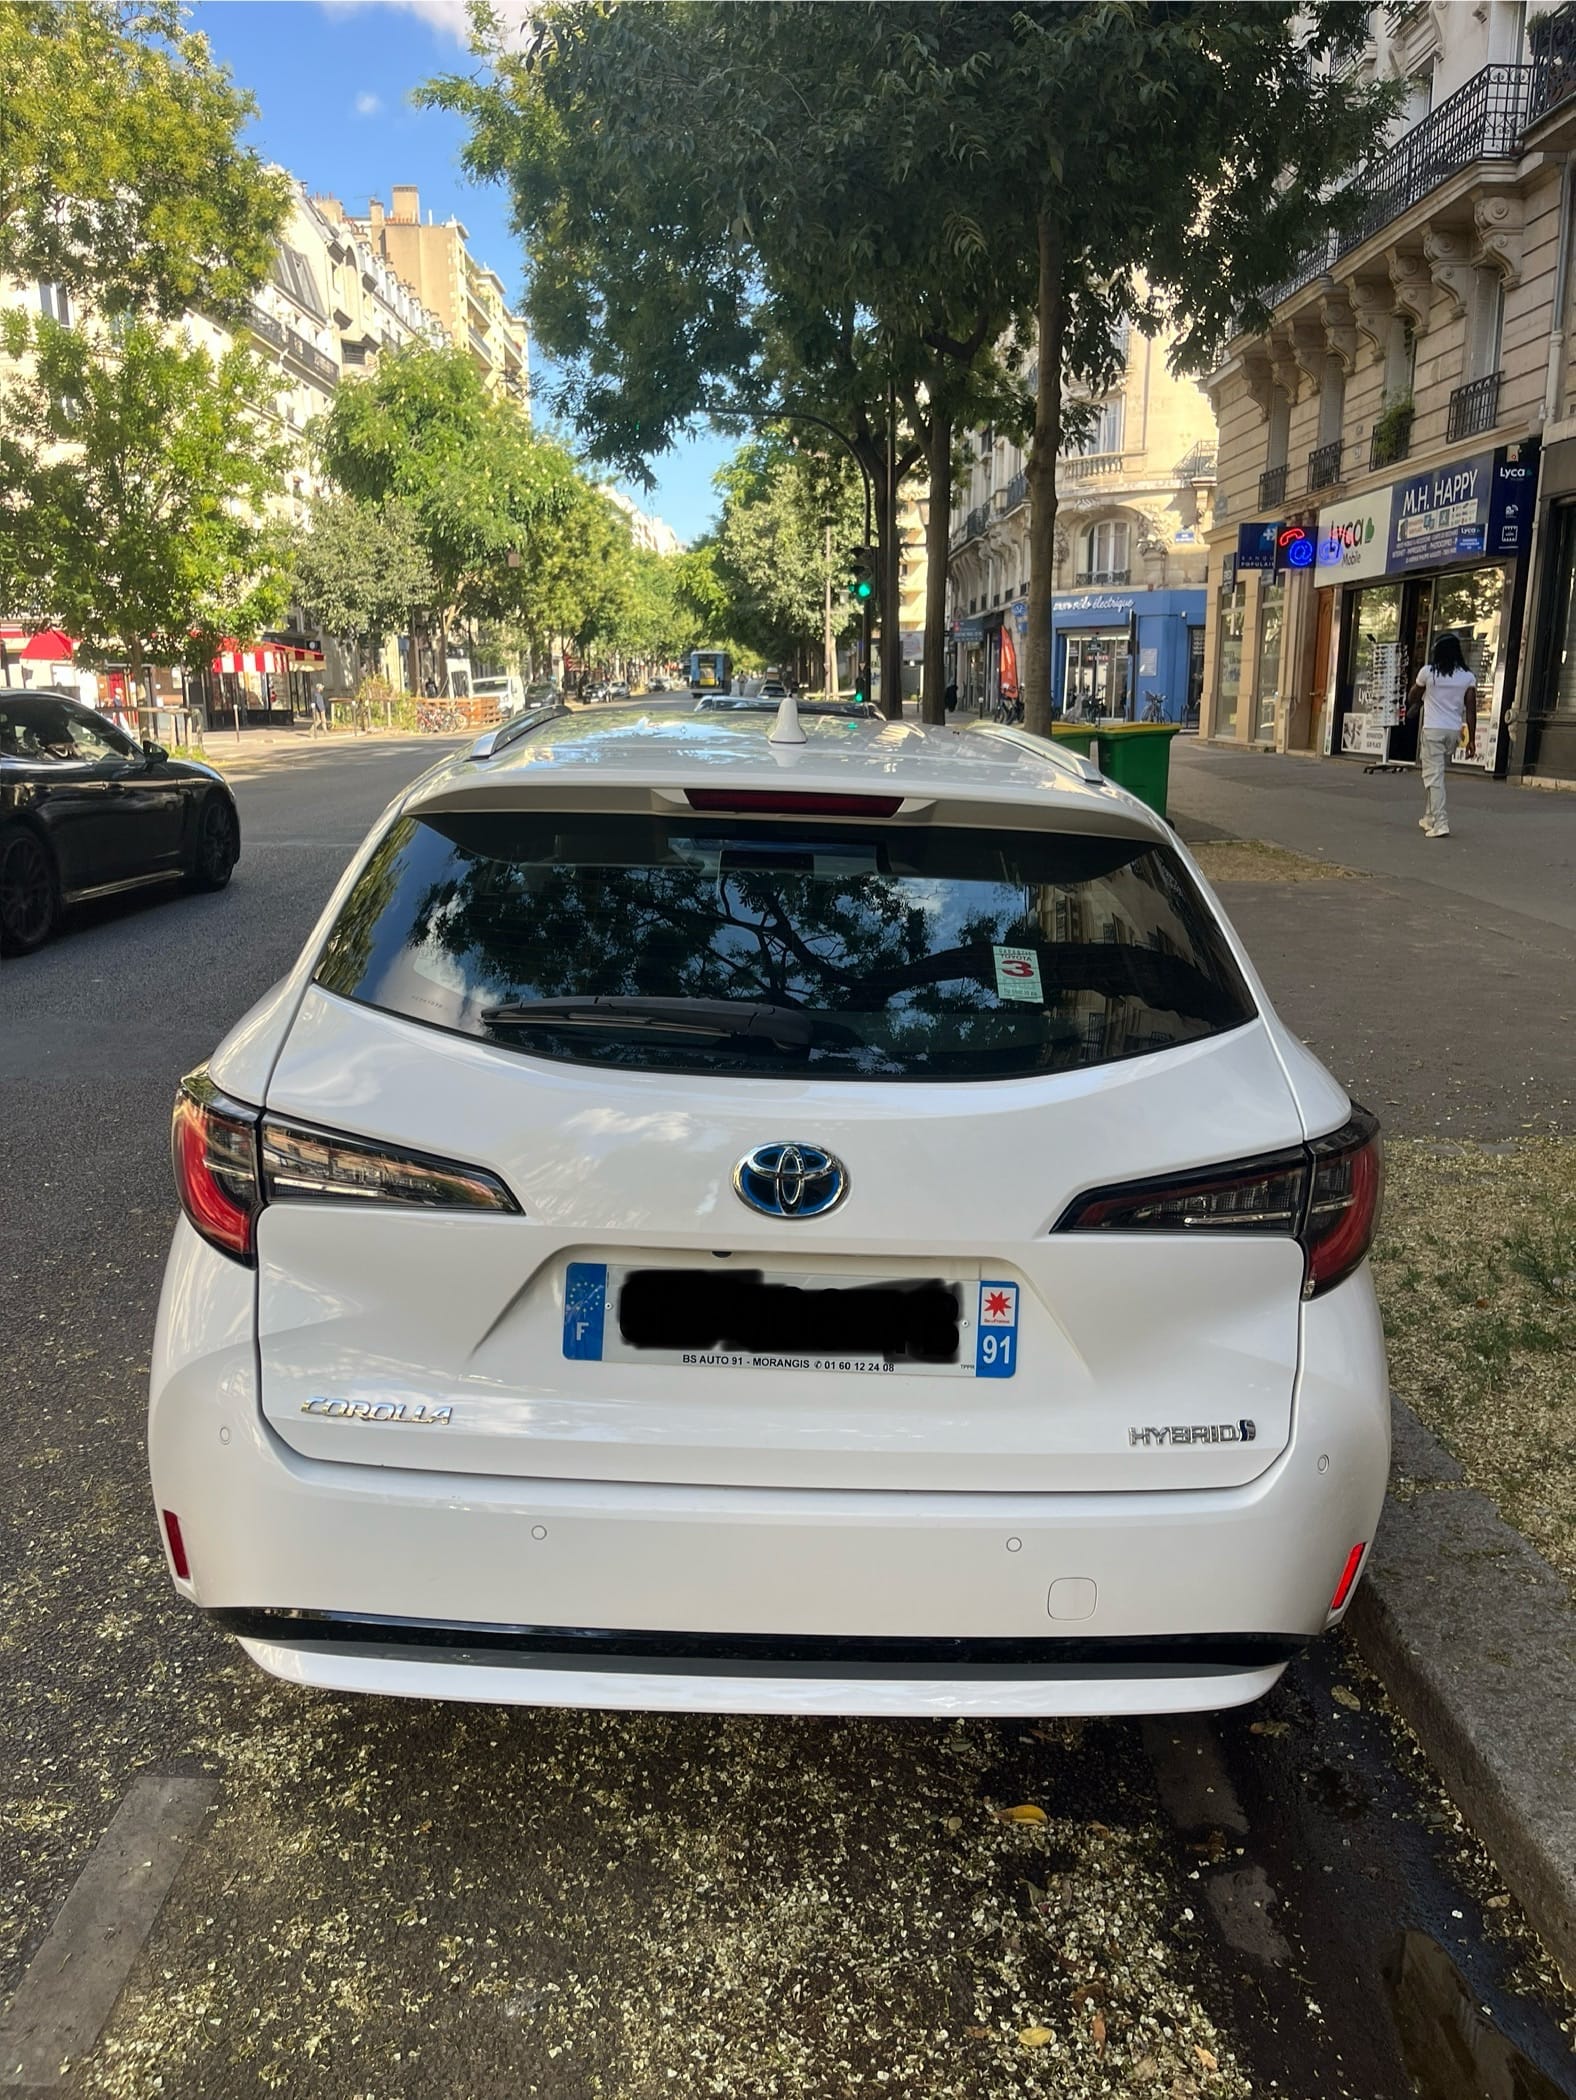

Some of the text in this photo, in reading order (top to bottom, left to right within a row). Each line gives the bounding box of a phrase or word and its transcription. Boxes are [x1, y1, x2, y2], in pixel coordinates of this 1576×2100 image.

[1499, 467, 1525, 479] Lyca
[1402, 468, 1478, 517] M.H. HAPPY
[1329, 517, 1364, 558] Lyca
[1341, 552, 1361, 567] Mobile
[1092, 595, 1134, 613] électrique
[1000, 953, 1033, 961] TOYOTA
[1001, 960, 1034, 978] 3
[576, 1322, 590, 1341] F
[982, 1335, 1011, 1365] 91
[682, 1354, 697, 1364] BS
[699, 1355, 729, 1365] AUTO
[731, 1356, 743, 1366] 91
[752, 1357, 810, 1369] MORANGIS
[824, 1361, 836, 1370] 01
[839, 1361, 851, 1371] 60
[855, 1361, 866, 1371] 12
[868, 1362, 880, 1372] 24
[882, 1363, 895, 1372] 08
[300, 1396, 453, 1425] COROLLA
[1128, 1424, 1240, 1445] HYBRID
